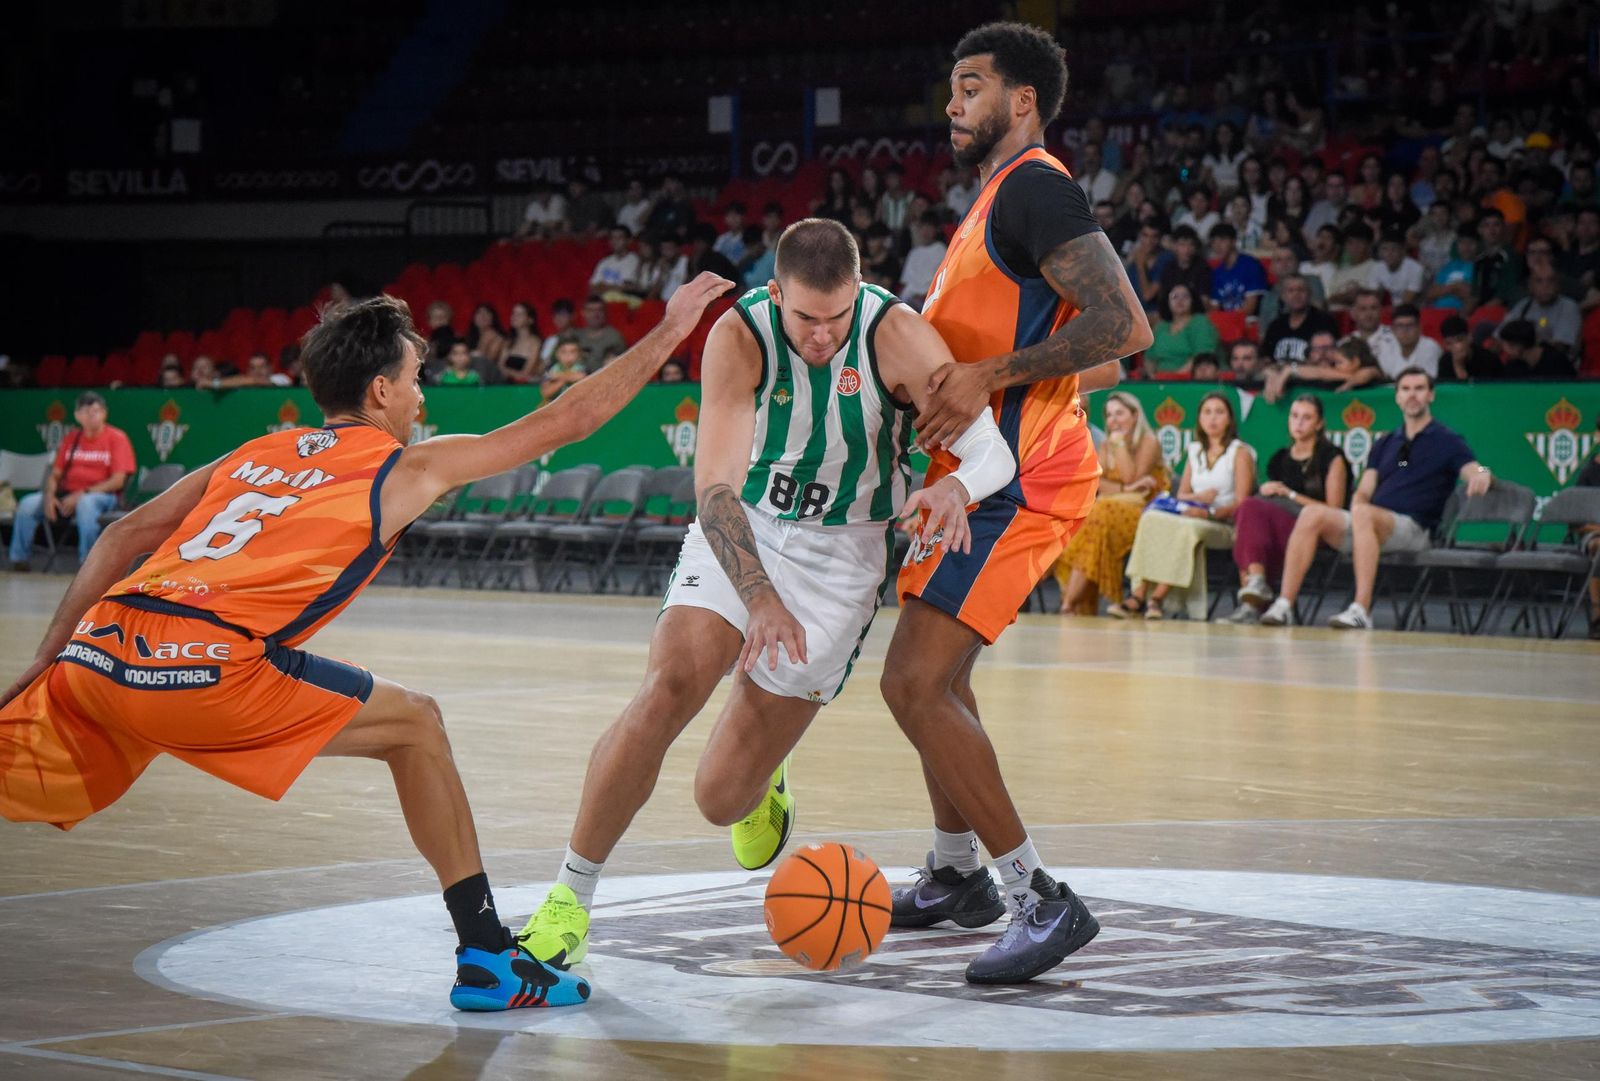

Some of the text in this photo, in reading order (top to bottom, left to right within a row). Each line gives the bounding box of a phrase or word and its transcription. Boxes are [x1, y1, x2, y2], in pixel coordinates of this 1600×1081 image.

[66, 168, 189, 195] SEVILLA
[768, 471, 831, 519] 88
[179, 490, 302, 561] 6
